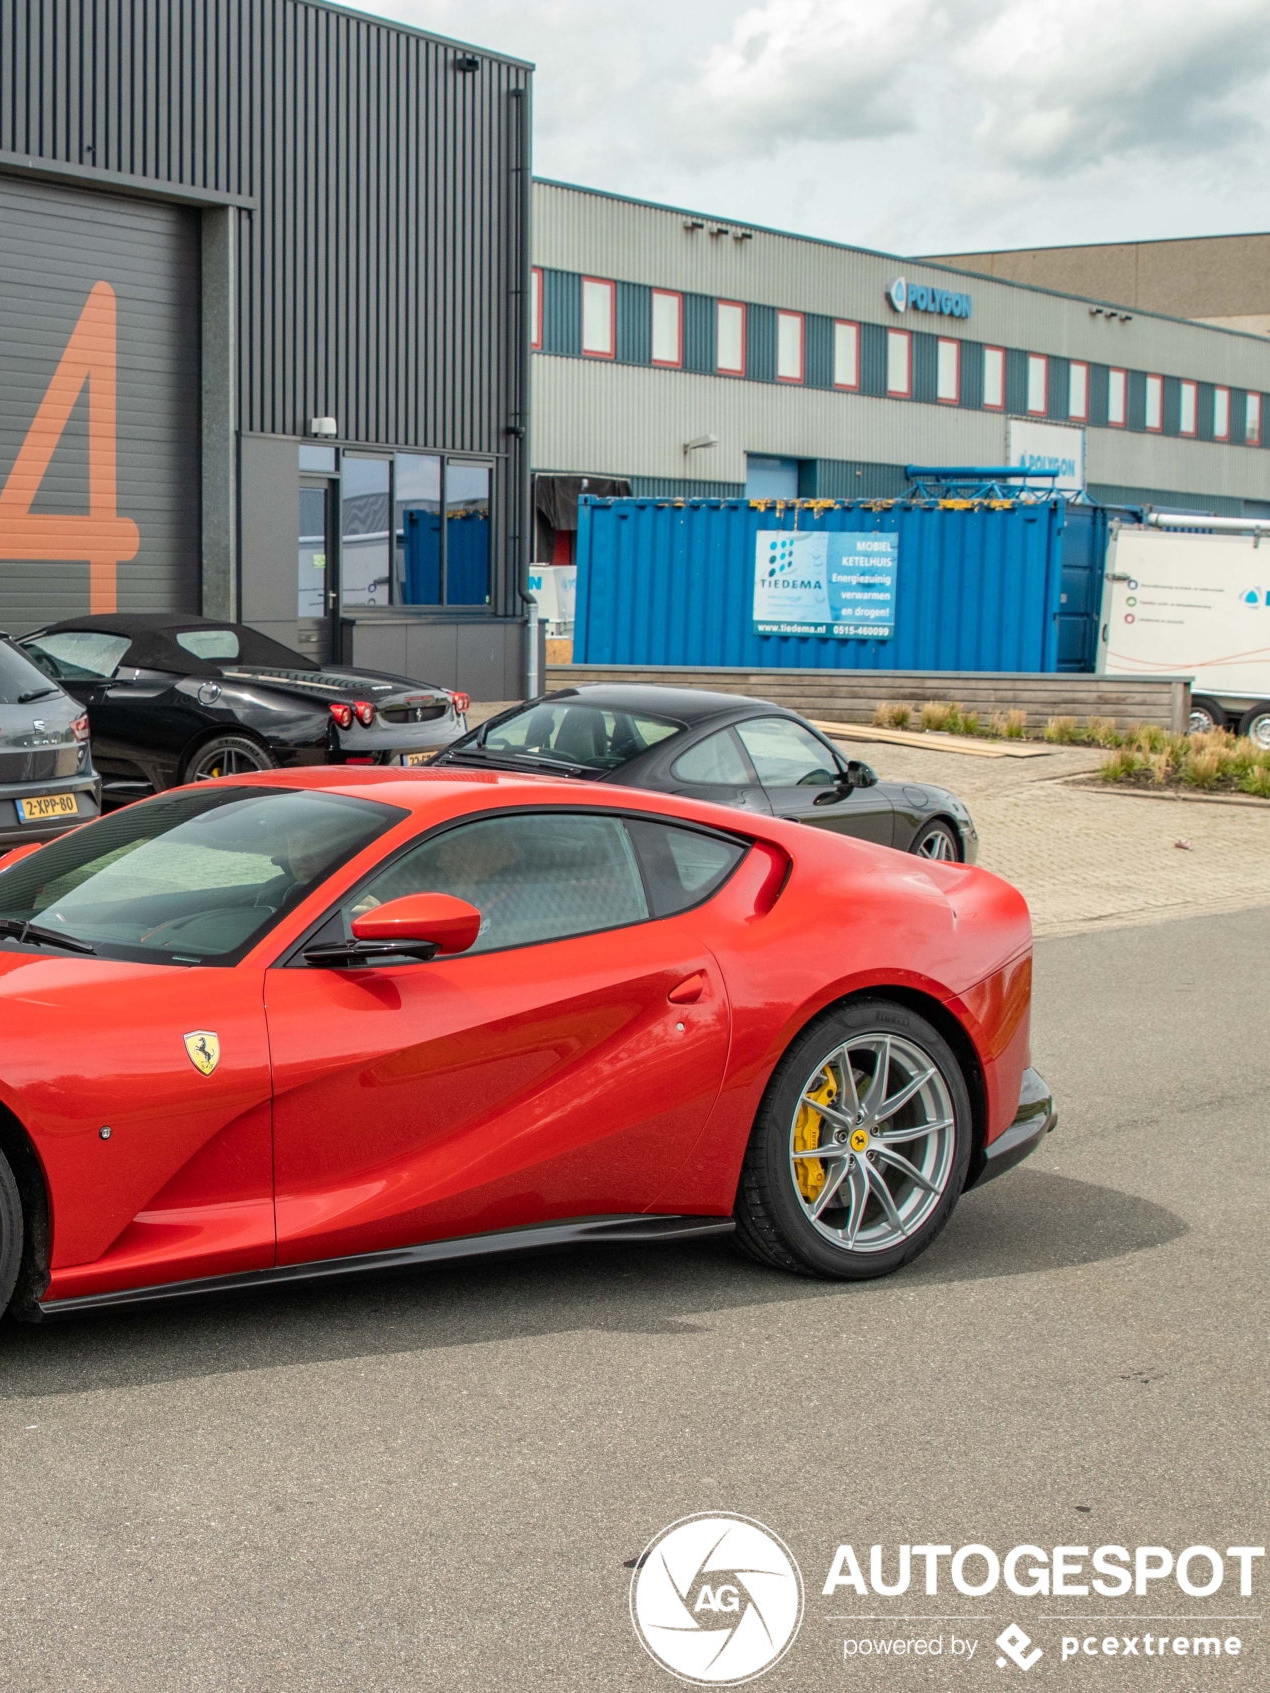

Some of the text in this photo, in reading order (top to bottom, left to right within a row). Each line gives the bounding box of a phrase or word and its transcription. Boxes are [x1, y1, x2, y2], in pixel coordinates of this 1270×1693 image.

[907, 283, 972, 318] POLYGON
[1029, 455, 1076, 477] POLYGON
[856, 541, 892, 552] MOBIEL
[842, 556, 892, 567] KETELHUIS
[760, 579, 822, 590] TIEDEMA
[831, 573, 892, 586] Energiezuinig
[841, 591, 890, 601] verwarmen
[841, 606, 890, 619] en drogen!
[757, 624, 889, 636] www.tiedema.nl 0515-460099
[26, 796, 74, 816] 2-XPP-80
